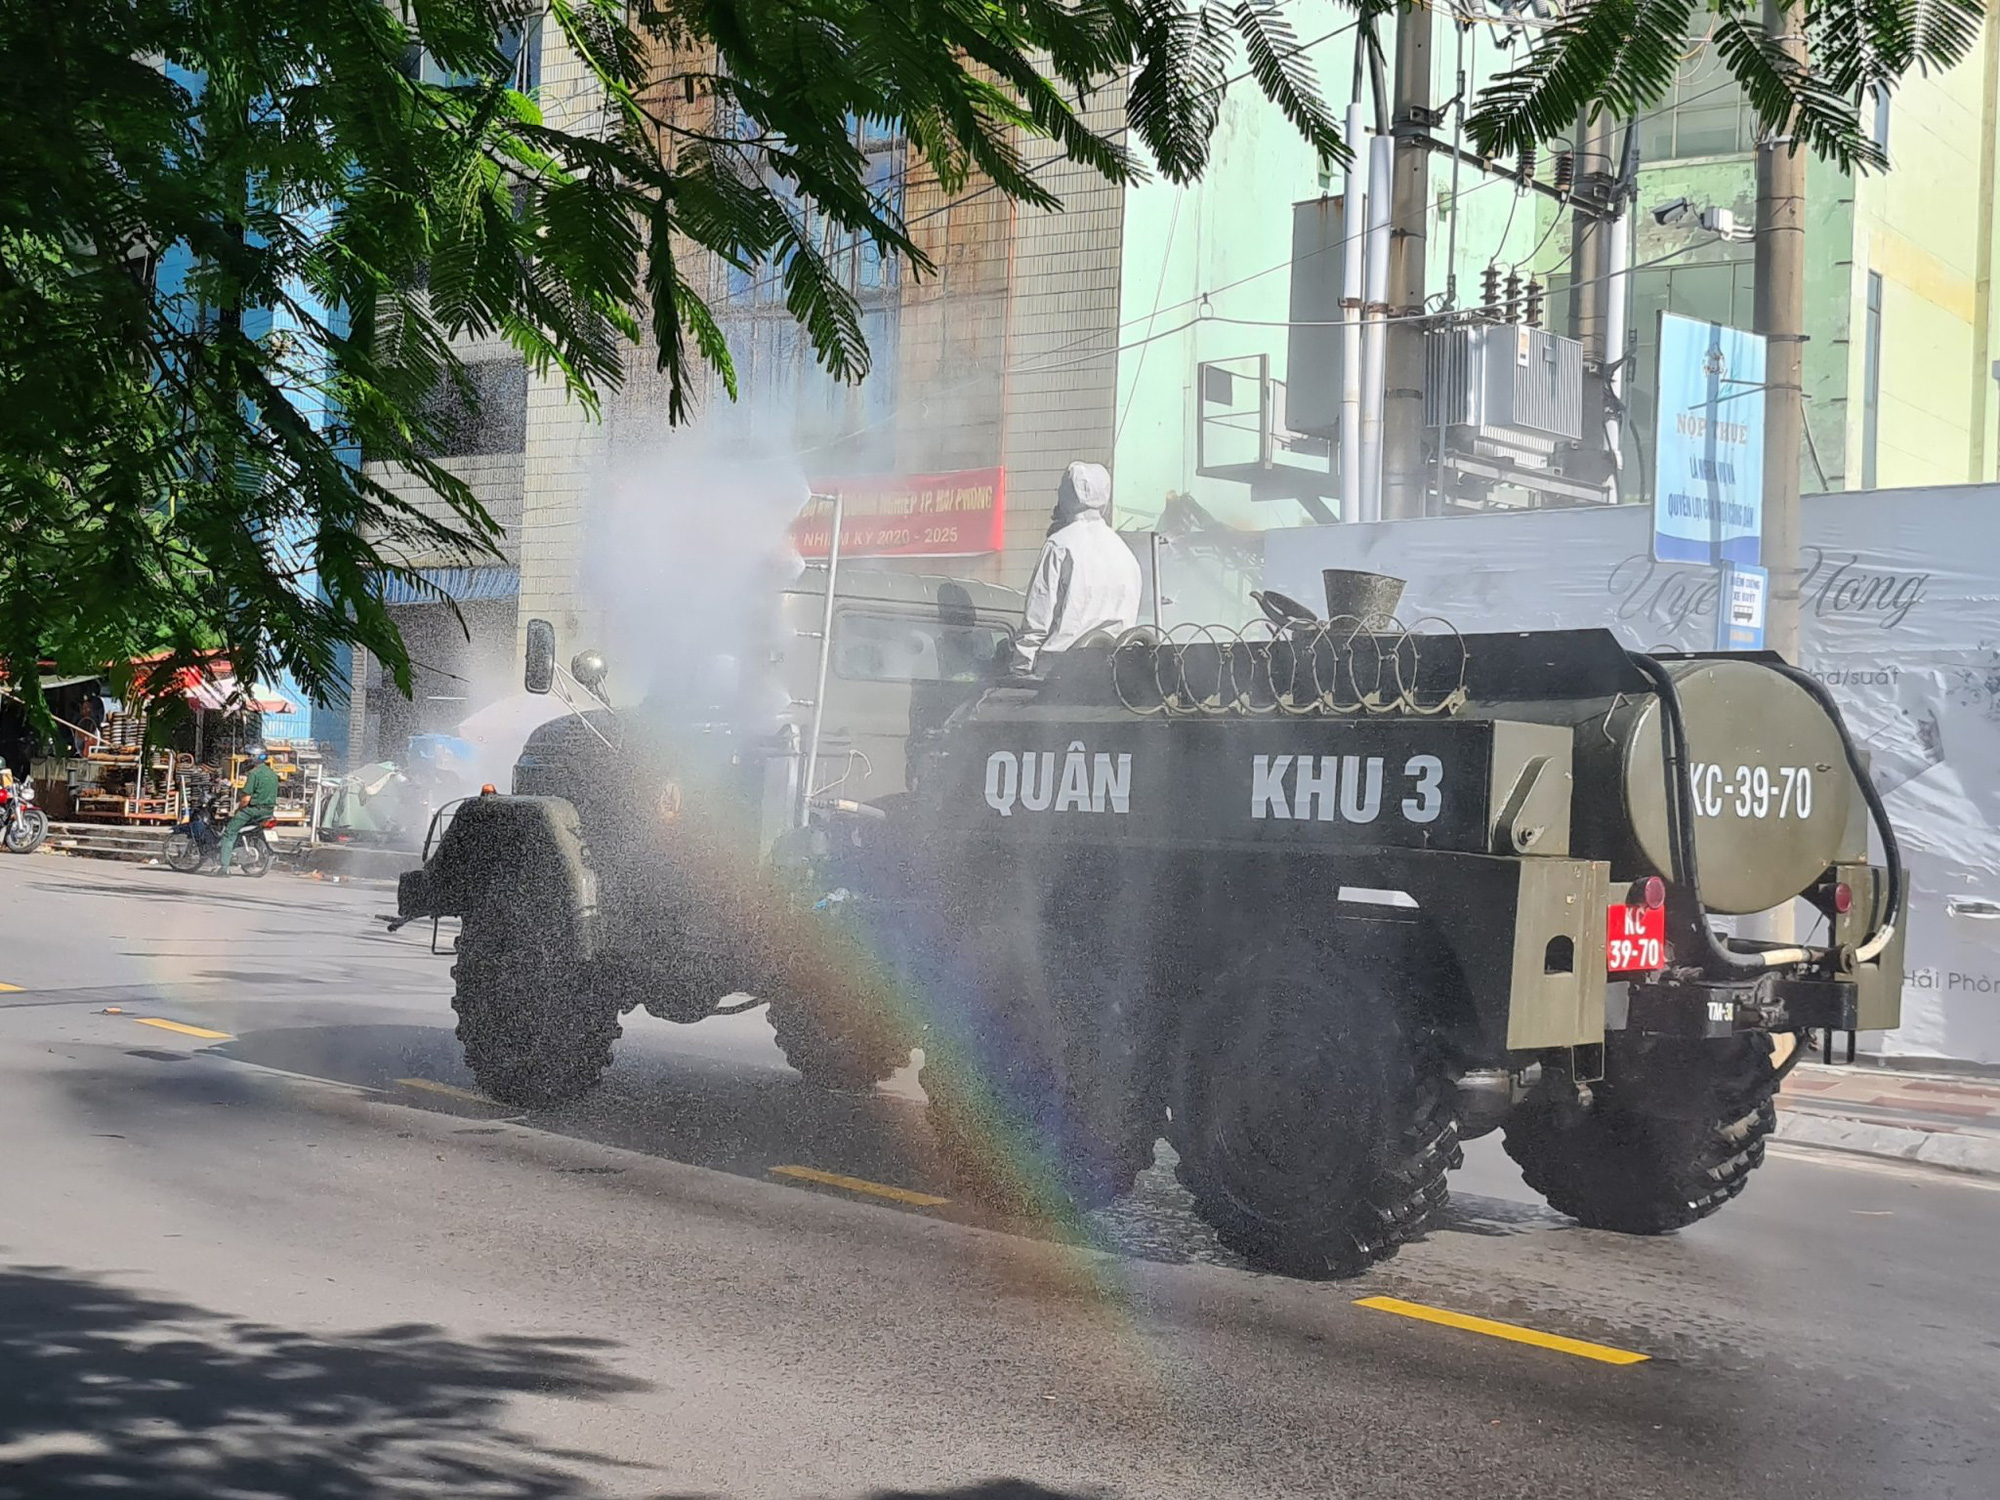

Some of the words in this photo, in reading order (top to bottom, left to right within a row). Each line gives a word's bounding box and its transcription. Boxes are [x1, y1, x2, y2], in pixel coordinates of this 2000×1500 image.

[876, 529, 909, 546] 2020
[924, 526, 958, 543] 2025
[984, 740, 1132, 816] QUÂN
[1251, 754, 1384, 823] KHU
[1401, 754, 1443, 823] 3
[1689, 762, 1811, 819] KC-39-70
[1625, 906, 1646, 935] KC
[1610, 938, 1659, 968] 39-70
